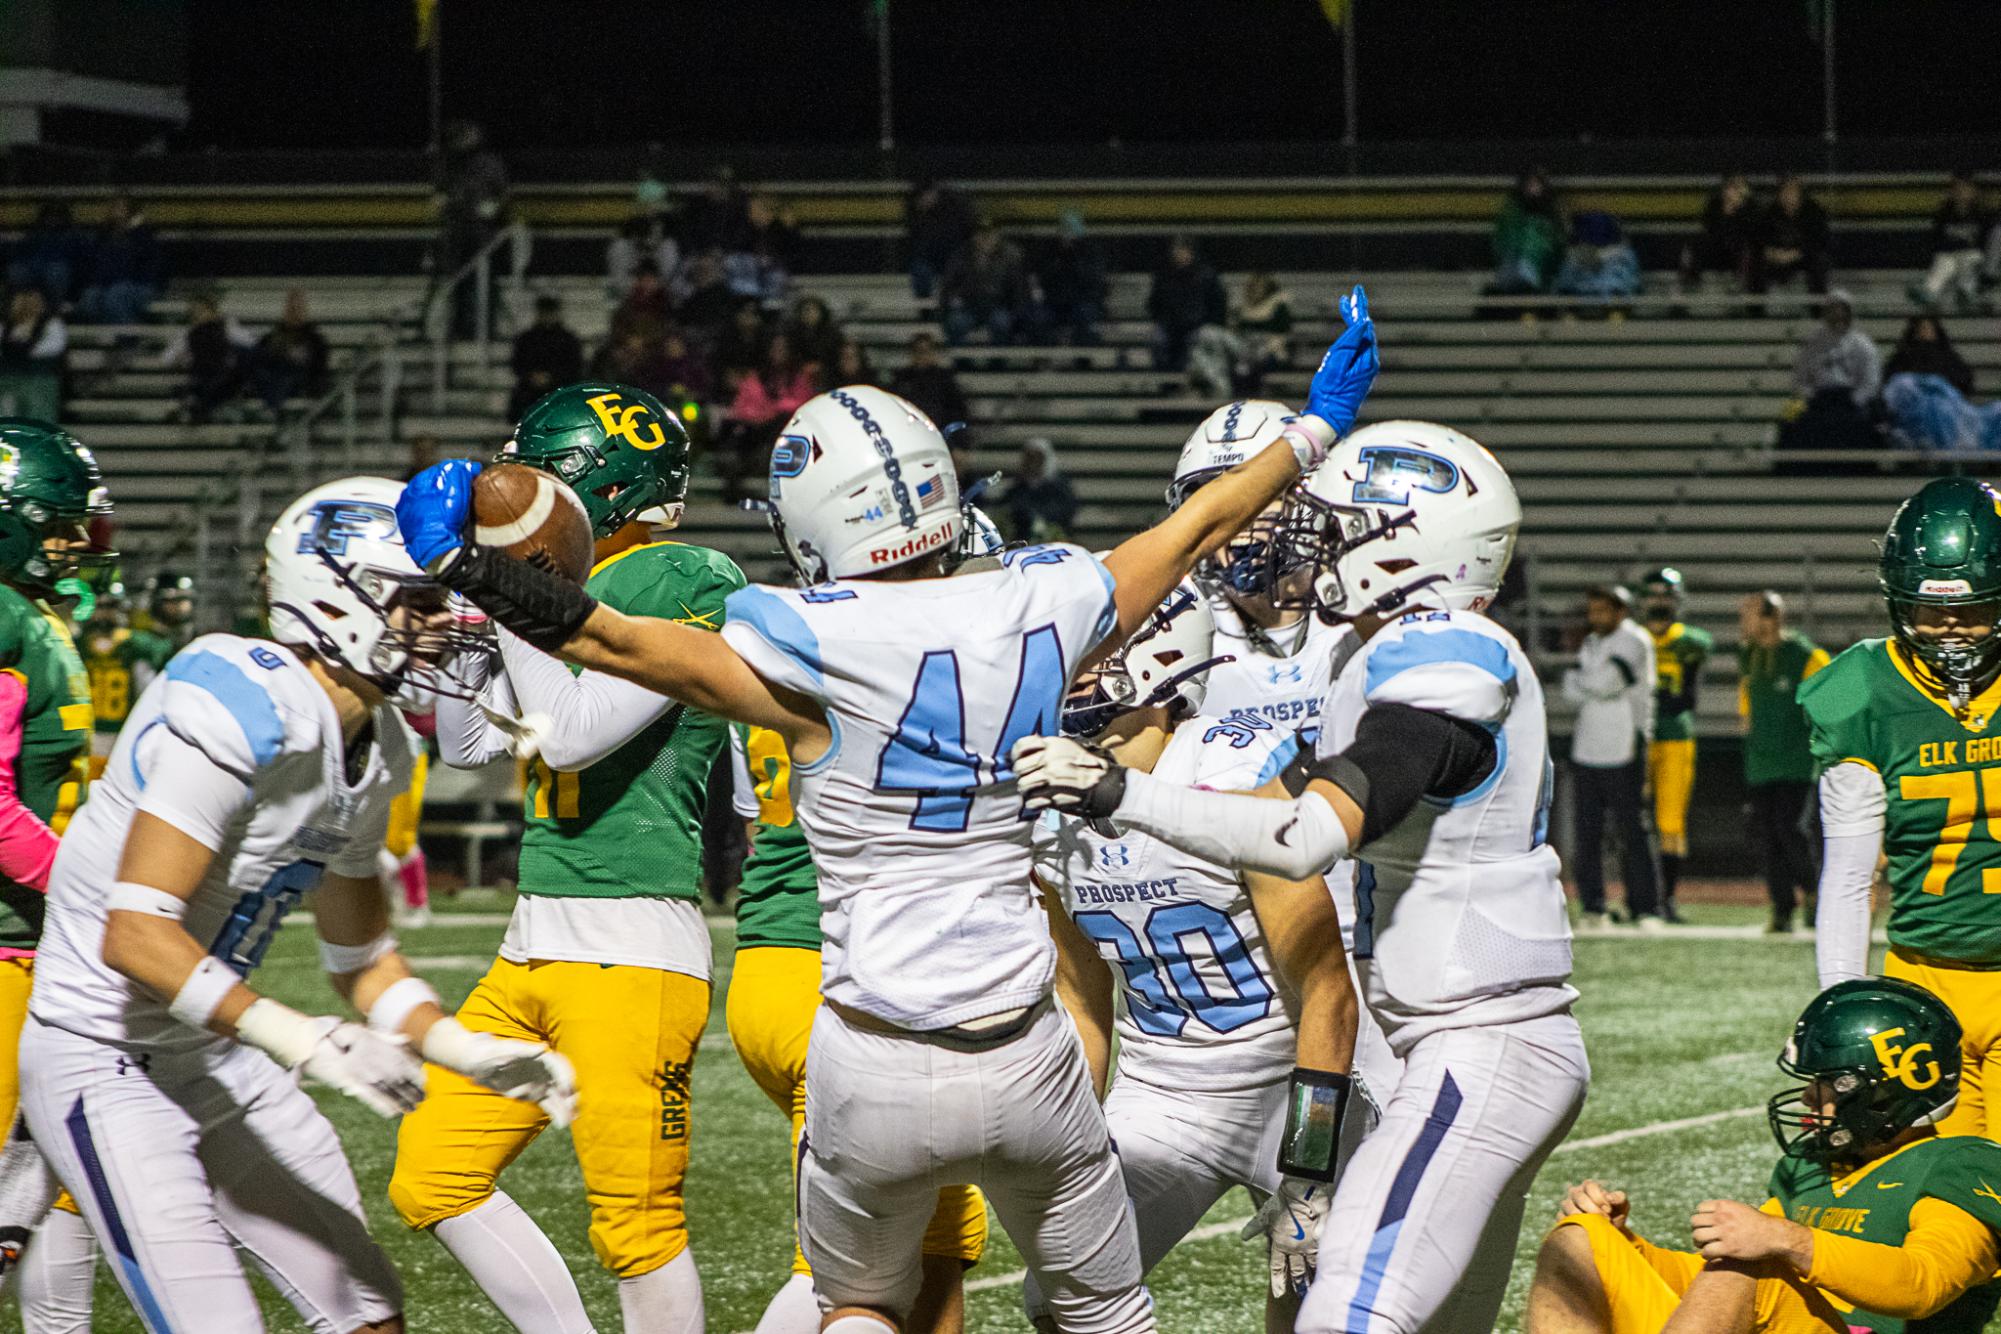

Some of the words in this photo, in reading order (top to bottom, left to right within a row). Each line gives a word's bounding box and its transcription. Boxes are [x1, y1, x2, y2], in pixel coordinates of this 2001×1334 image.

[585, 393, 667, 451] EG
[1352, 446, 1459, 506] P
[870, 521, 953, 564] Riddell
[874, 622, 1067, 832] 44
[1919, 741, 1958, 767] ELK
[1074, 877, 1181, 904] PROSPECT
[1073, 899, 1275, 1037] 30
[1867, 1026, 1942, 1091] EG
